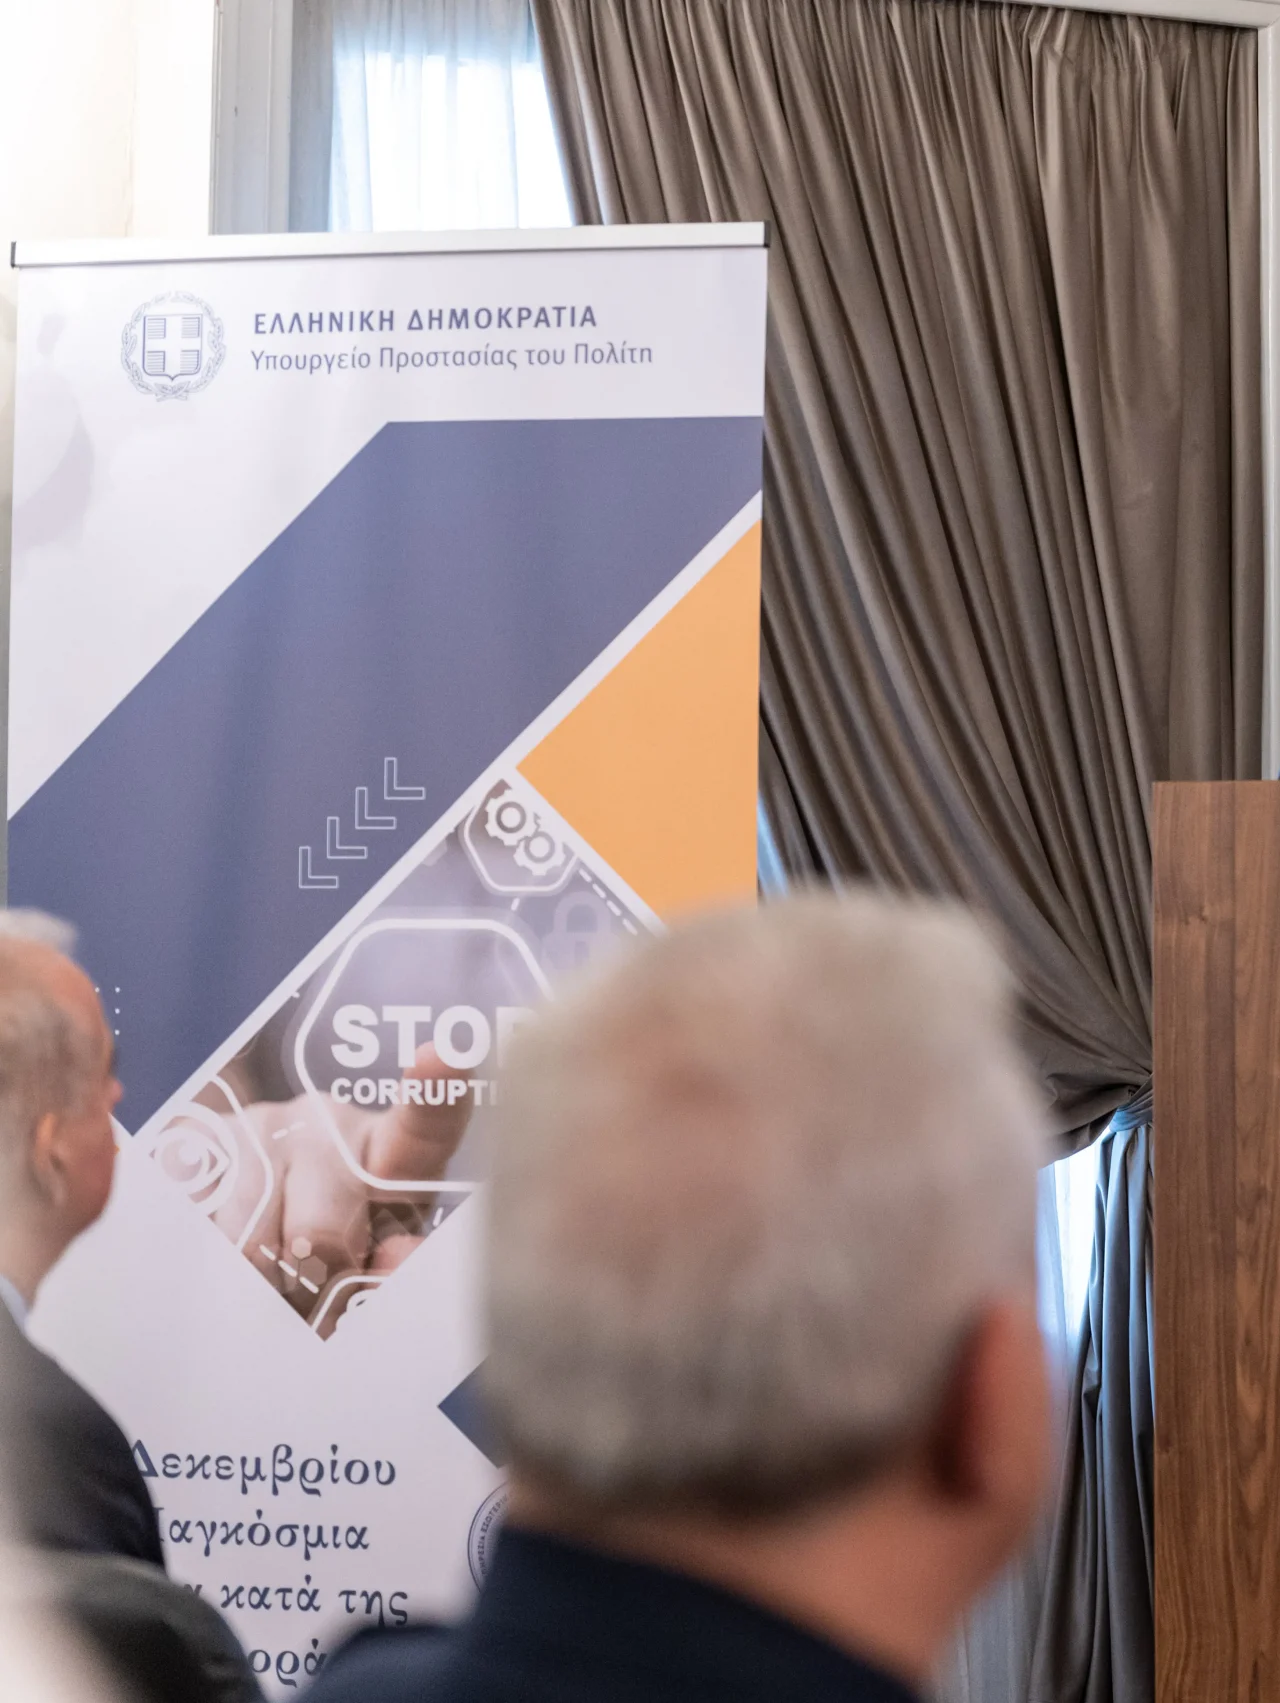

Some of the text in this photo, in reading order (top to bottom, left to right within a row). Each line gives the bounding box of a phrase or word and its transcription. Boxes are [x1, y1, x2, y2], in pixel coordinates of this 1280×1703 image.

[254, 305, 597, 334] ΕΛΛΗΝΙΚΗ ΔΗΜΟΚΡΑΤΙΑ
[251, 340, 653, 375] Υπουργείο Προστασίας του Πολίτη
[220, 1574, 409, 1627] κατά της
